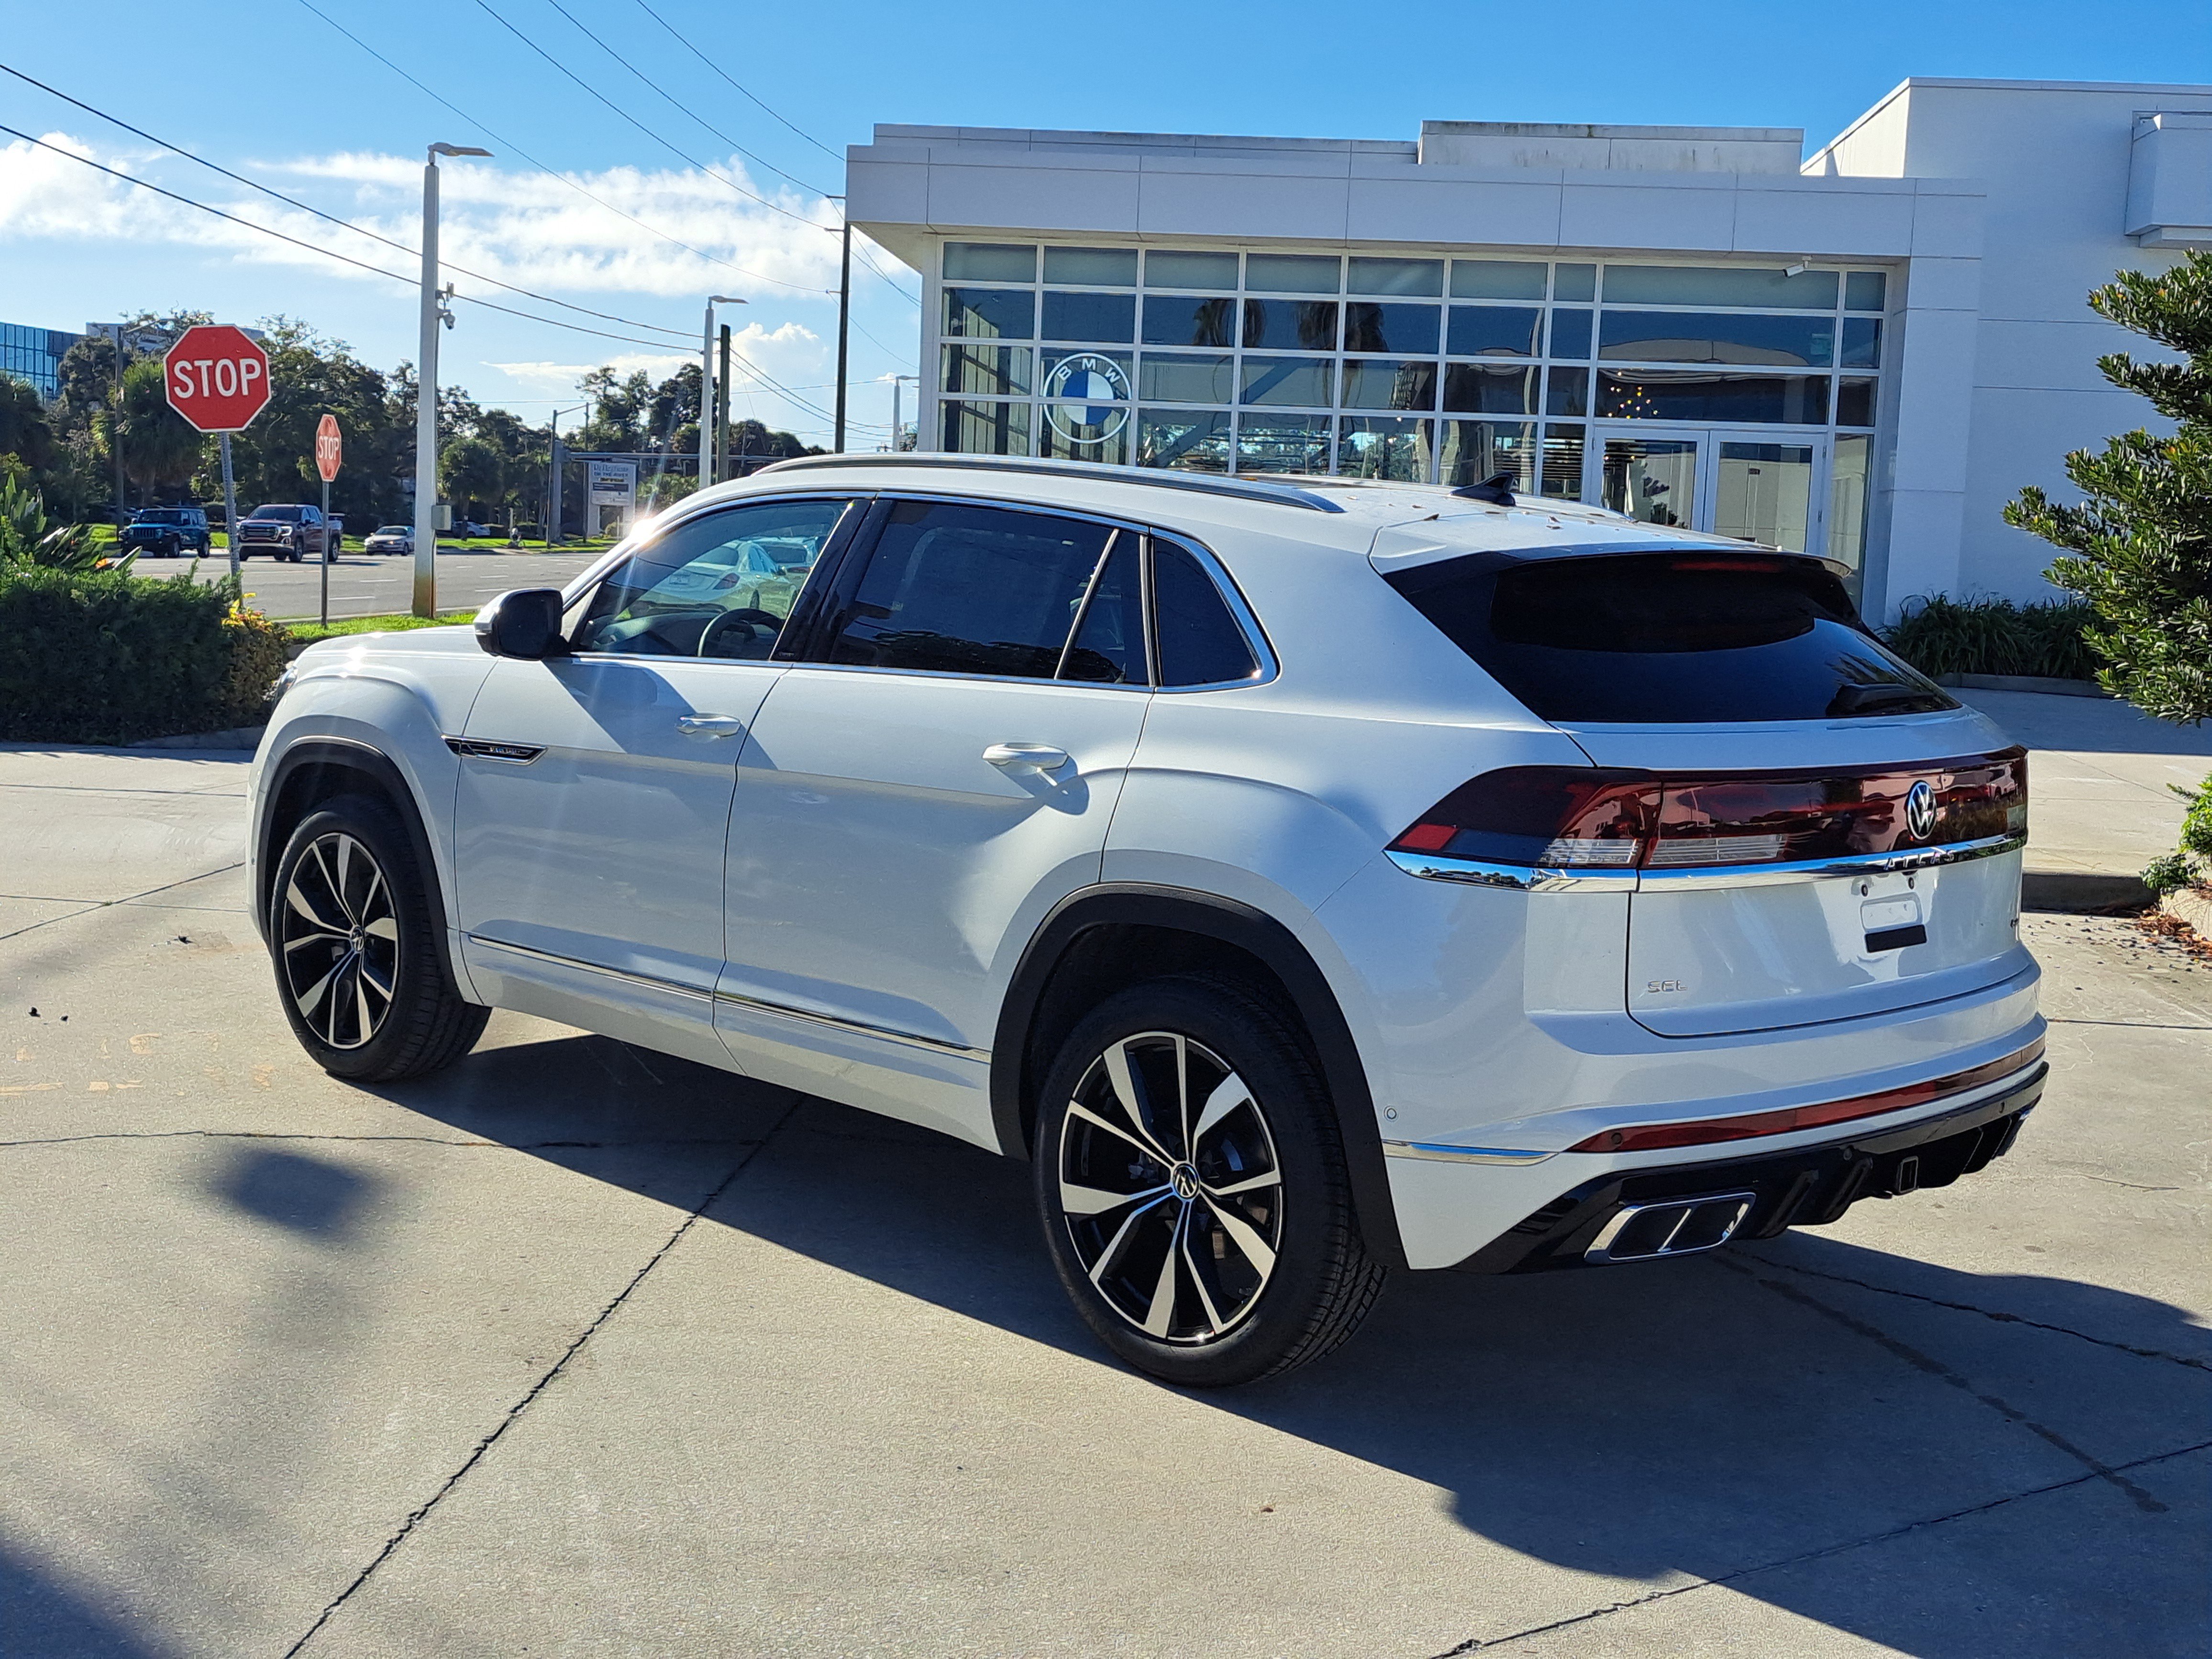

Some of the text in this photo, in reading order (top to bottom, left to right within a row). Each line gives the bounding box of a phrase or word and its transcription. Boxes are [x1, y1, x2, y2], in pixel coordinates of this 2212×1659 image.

[174, 358, 261, 398] STOP
[1057, 358, 1121, 383] BMW
[318, 435, 340, 461] STOP
[1883, 850, 1955, 871] ATLAS
[1647, 979, 1688, 994] SEL
